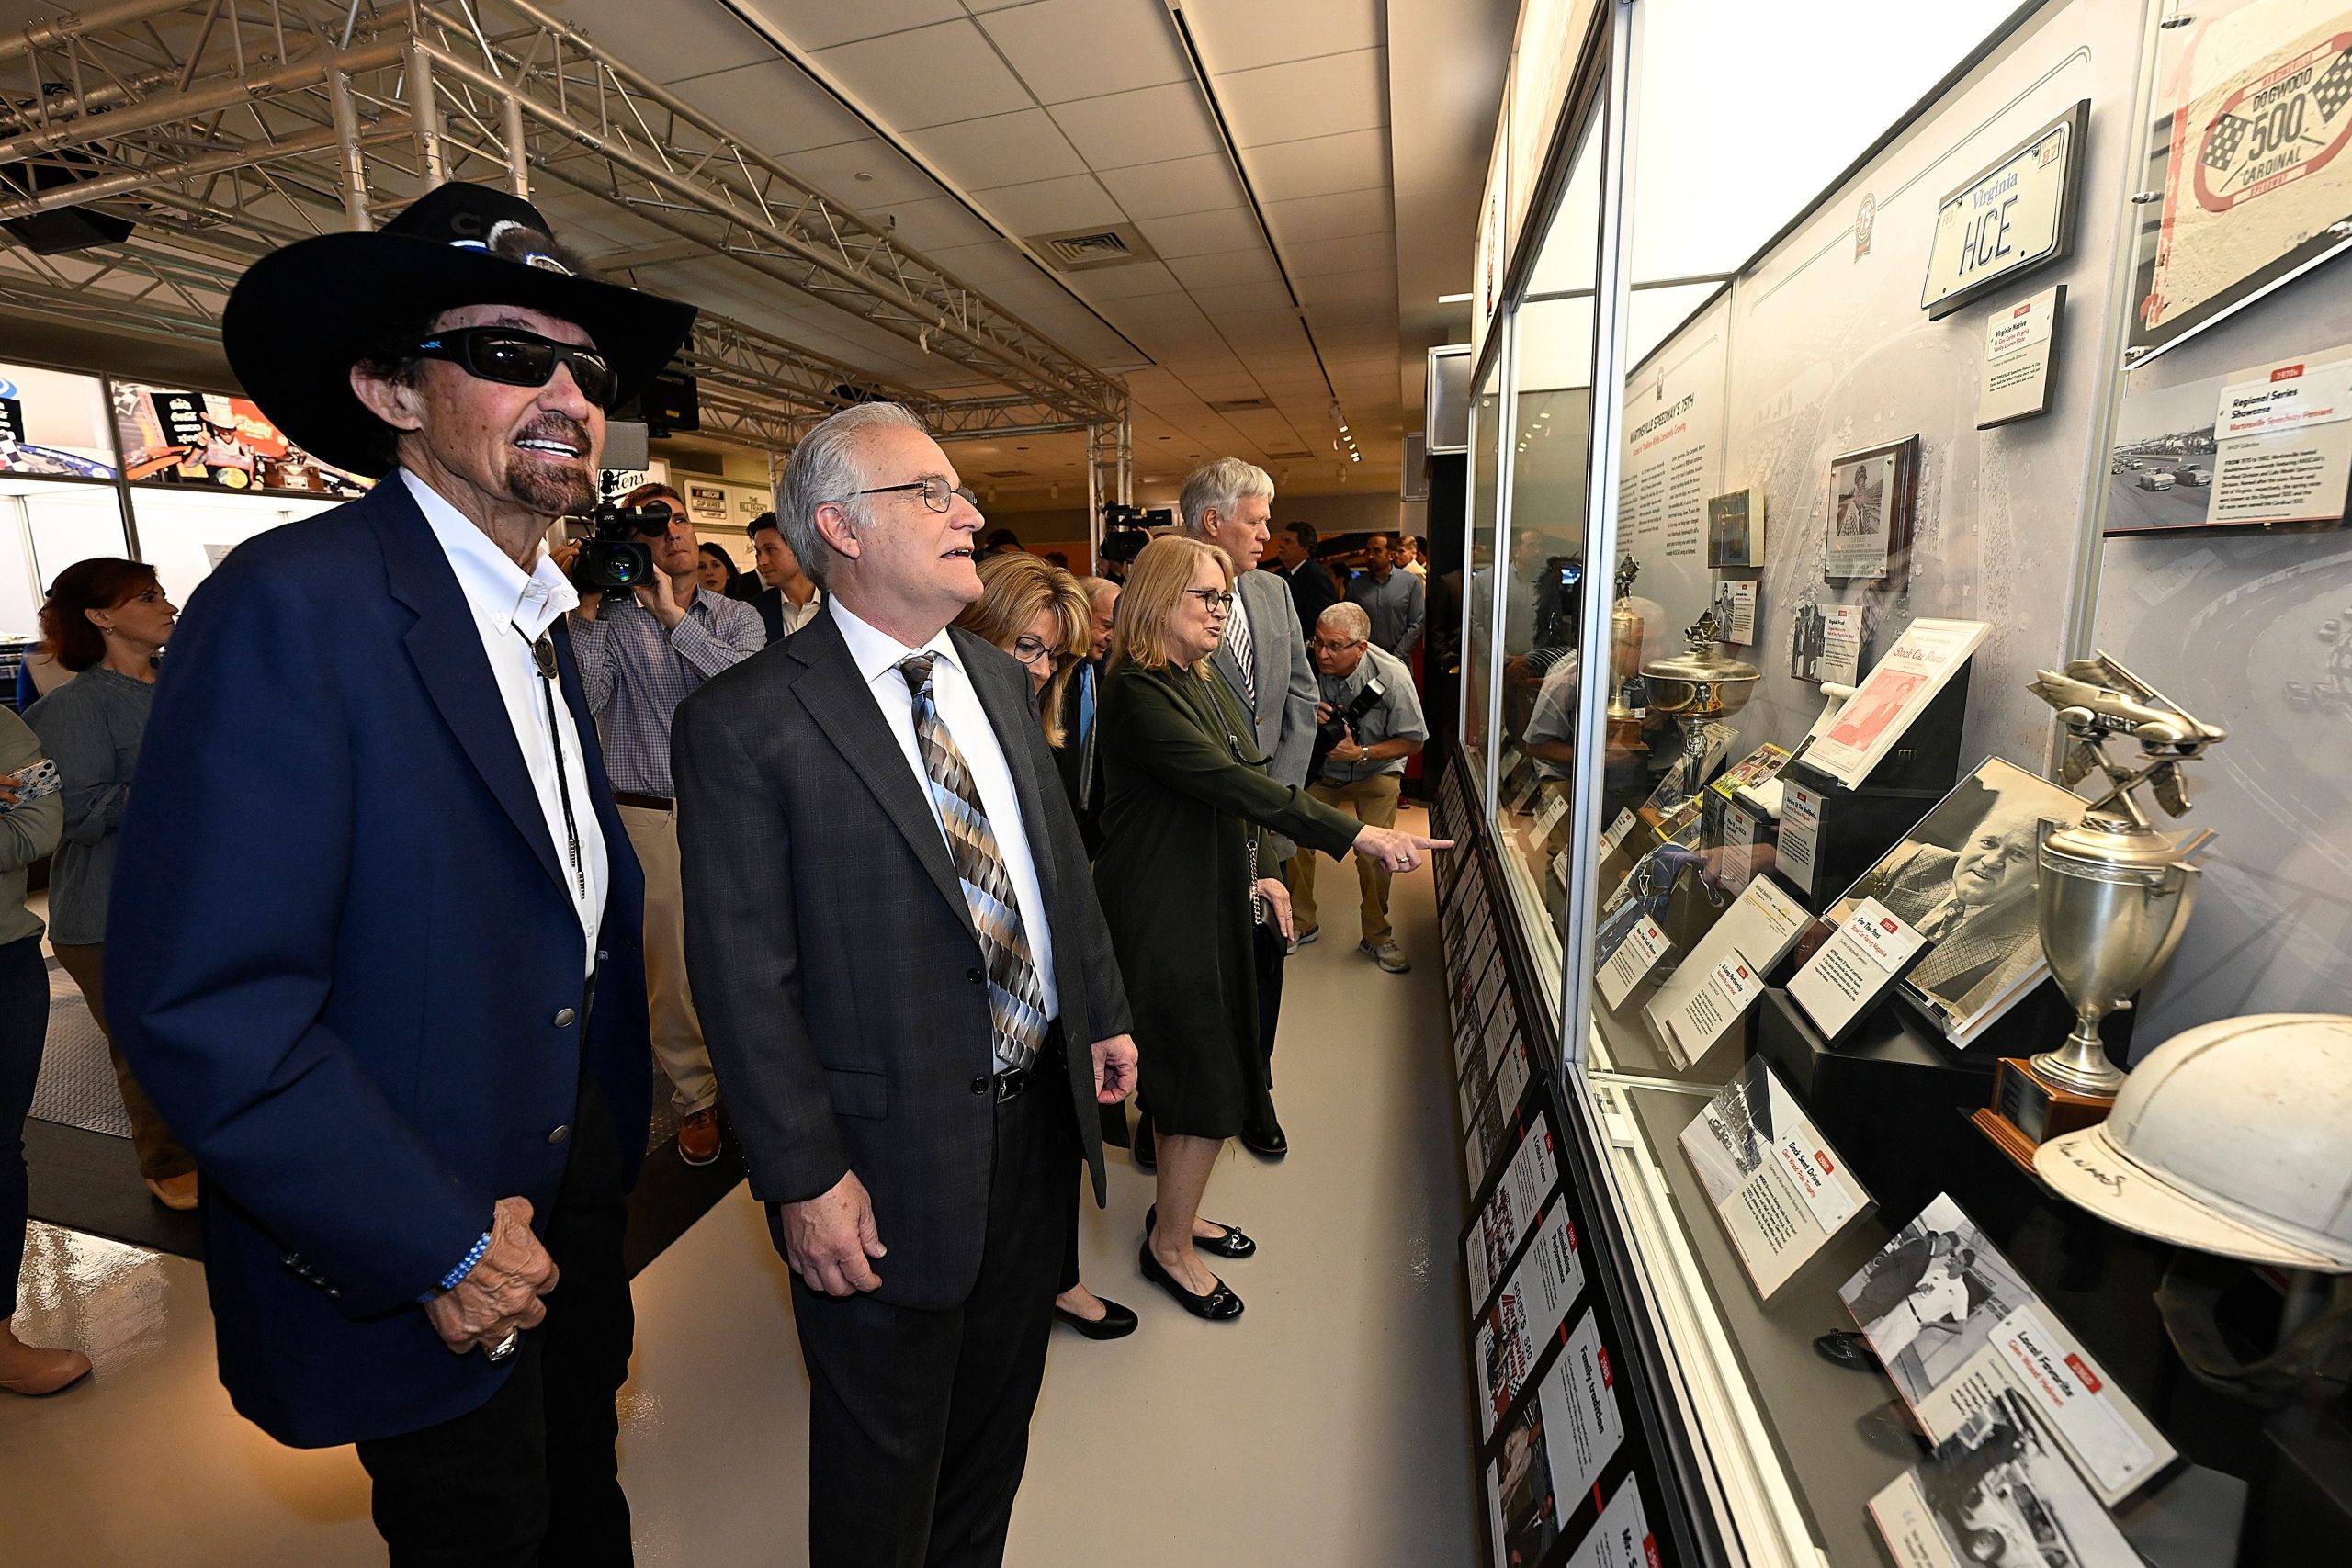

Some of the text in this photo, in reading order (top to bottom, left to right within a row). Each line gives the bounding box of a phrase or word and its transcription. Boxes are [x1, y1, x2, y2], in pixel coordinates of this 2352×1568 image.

[2252, 67, 2313, 112] DOGWOOD
[2248, 93, 2306, 161] 500
[2041, 142, 2059, 164] 87
[2242, 146, 2301, 186] CARDINAL
[1973, 172, 2018, 209] Virginia
[1958, 193, 2018, 276] HCE
[1996, 321, 2027, 338] Virginia Native
[2016, 328, 2030, 338] Virginia
[2016, 336, 2026, 344] Plate
[2231, 406, 2271, 419] Showcase
[2233, 389, 2298, 407] Regional Series
[1630, 392, 1694, 444] MARTINSVILLE SPEEDWAY'S 75TH
[2230, 408, 2334, 431] Martinsville Speedway Pennant
[1894, 647, 1913, 660] Stock
[1912, 649, 1924, 660] Car
[1851, 925, 1860, 934] Stock
[1864, 934, 1874, 946] Racing
[1873, 942, 1888, 957] Magazine
[1857, 917, 1881, 939] For The Fans
[1729, 973, 1743, 992] Partnership
[1534, 1139, 1543, 1161] Critical
[1788, 1141, 1822, 1187] Back Seat Driver
[1789, 1157, 1800, 1172] Wood
[1804, 1179, 1816, 1199] Trophy
[1551, 1235, 1566, 1285] Performance
[1557, 1224, 1571, 1275] Intimidating
[1513, 1280, 1533, 1361] GOODY'S 500
[2008, 1339, 2064, 1408] Glen Wood Helmet
[2018, 1330, 2074, 1396] Local Favorite
[1580, 1345, 1605, 1434] Family tradition
[1622, 1527, 1631, 1557] Mr.
